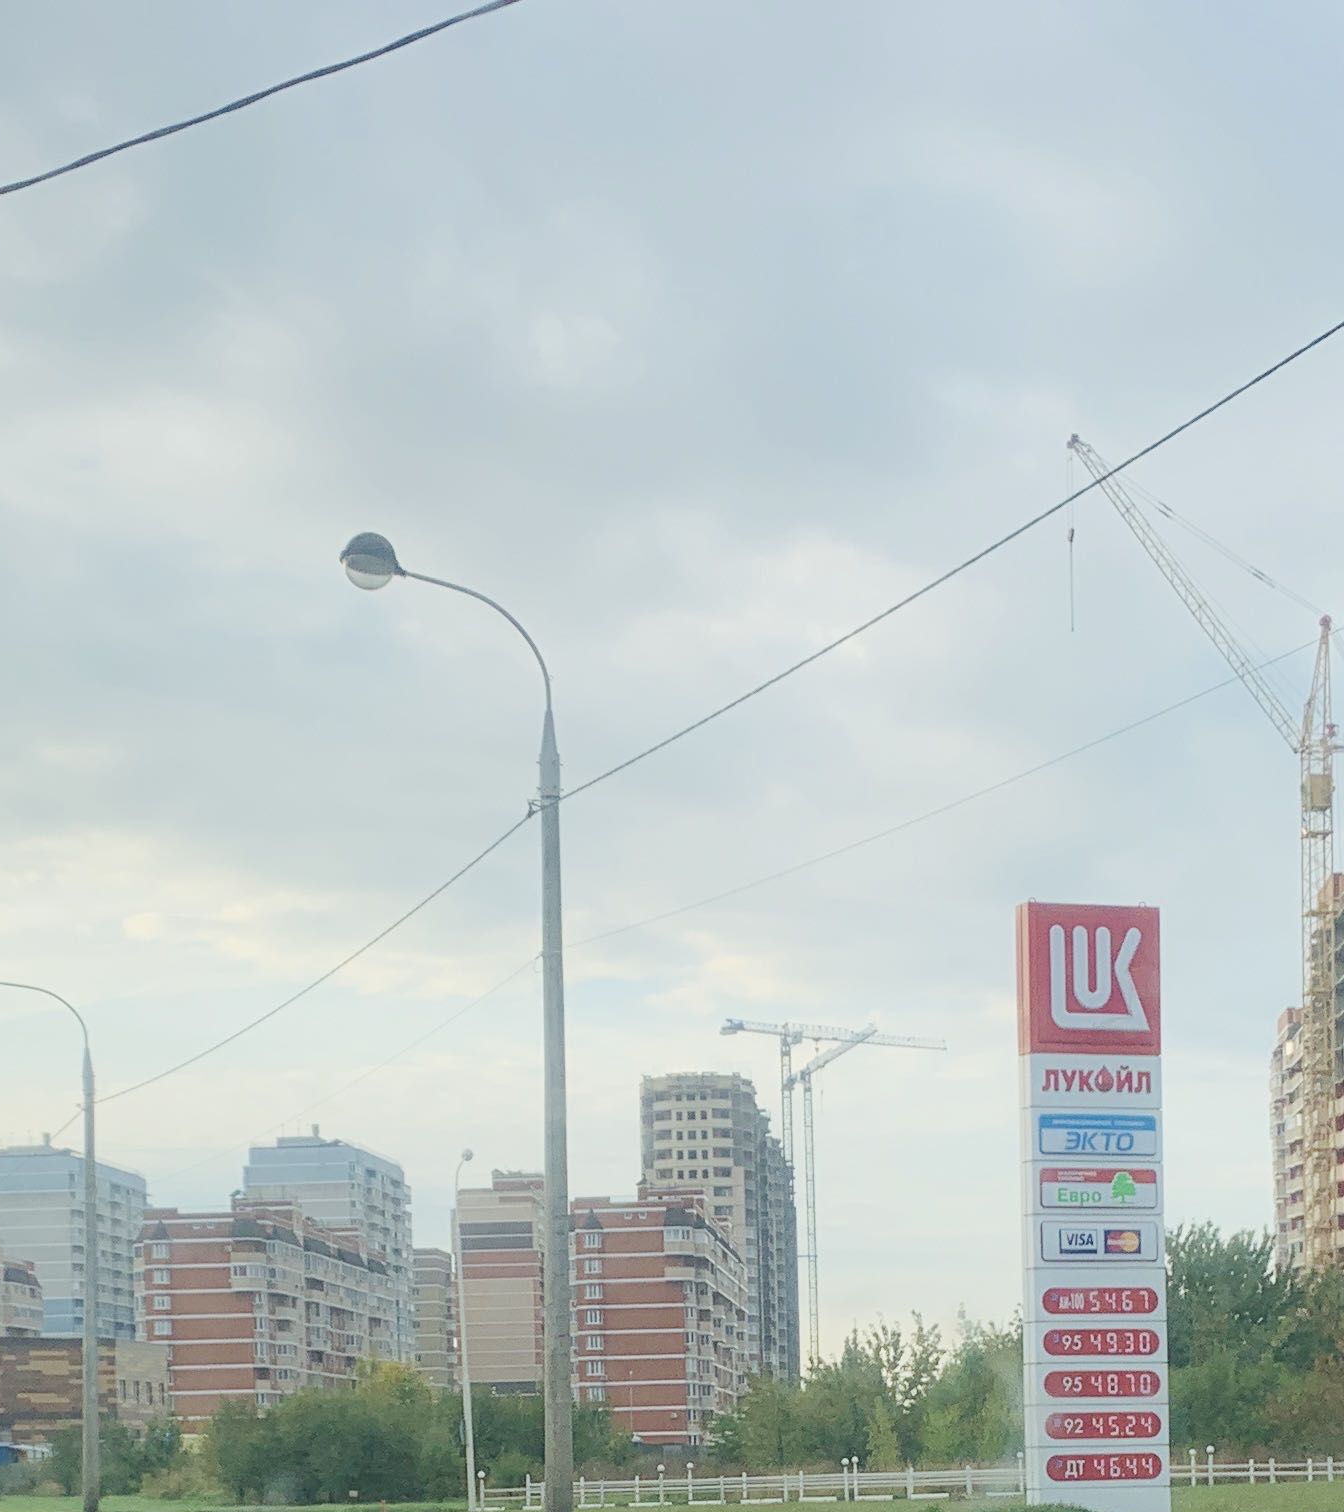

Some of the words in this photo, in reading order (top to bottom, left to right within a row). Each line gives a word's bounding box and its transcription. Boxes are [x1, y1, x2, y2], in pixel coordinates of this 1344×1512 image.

[1042, 1065, 1152, 1094] ЛУКОЙЛ
[1064, 1131, 1135, 1152] ЭКТО
[1057, 1187, 1102, 1207] Евро
[1067, 1233, 1094, 1246] VISA
[1089, 1291, 1150, 1312] 54.67
[1062, 1334, 1082, 1351] 95
[1090, 1332, 1151, 1353] 49.30
[1062, 1376, 1083, 1393] 95
[1091, 1374, 1151, 1395] 48.70
[1064, 1418, 1084, 1435] 92
[1092, 1415, 1153, 1437] 45.24
[1064, 1459, 1086, 1479] ДТ
[1093, 1457, 1154, 1478] 46.44
